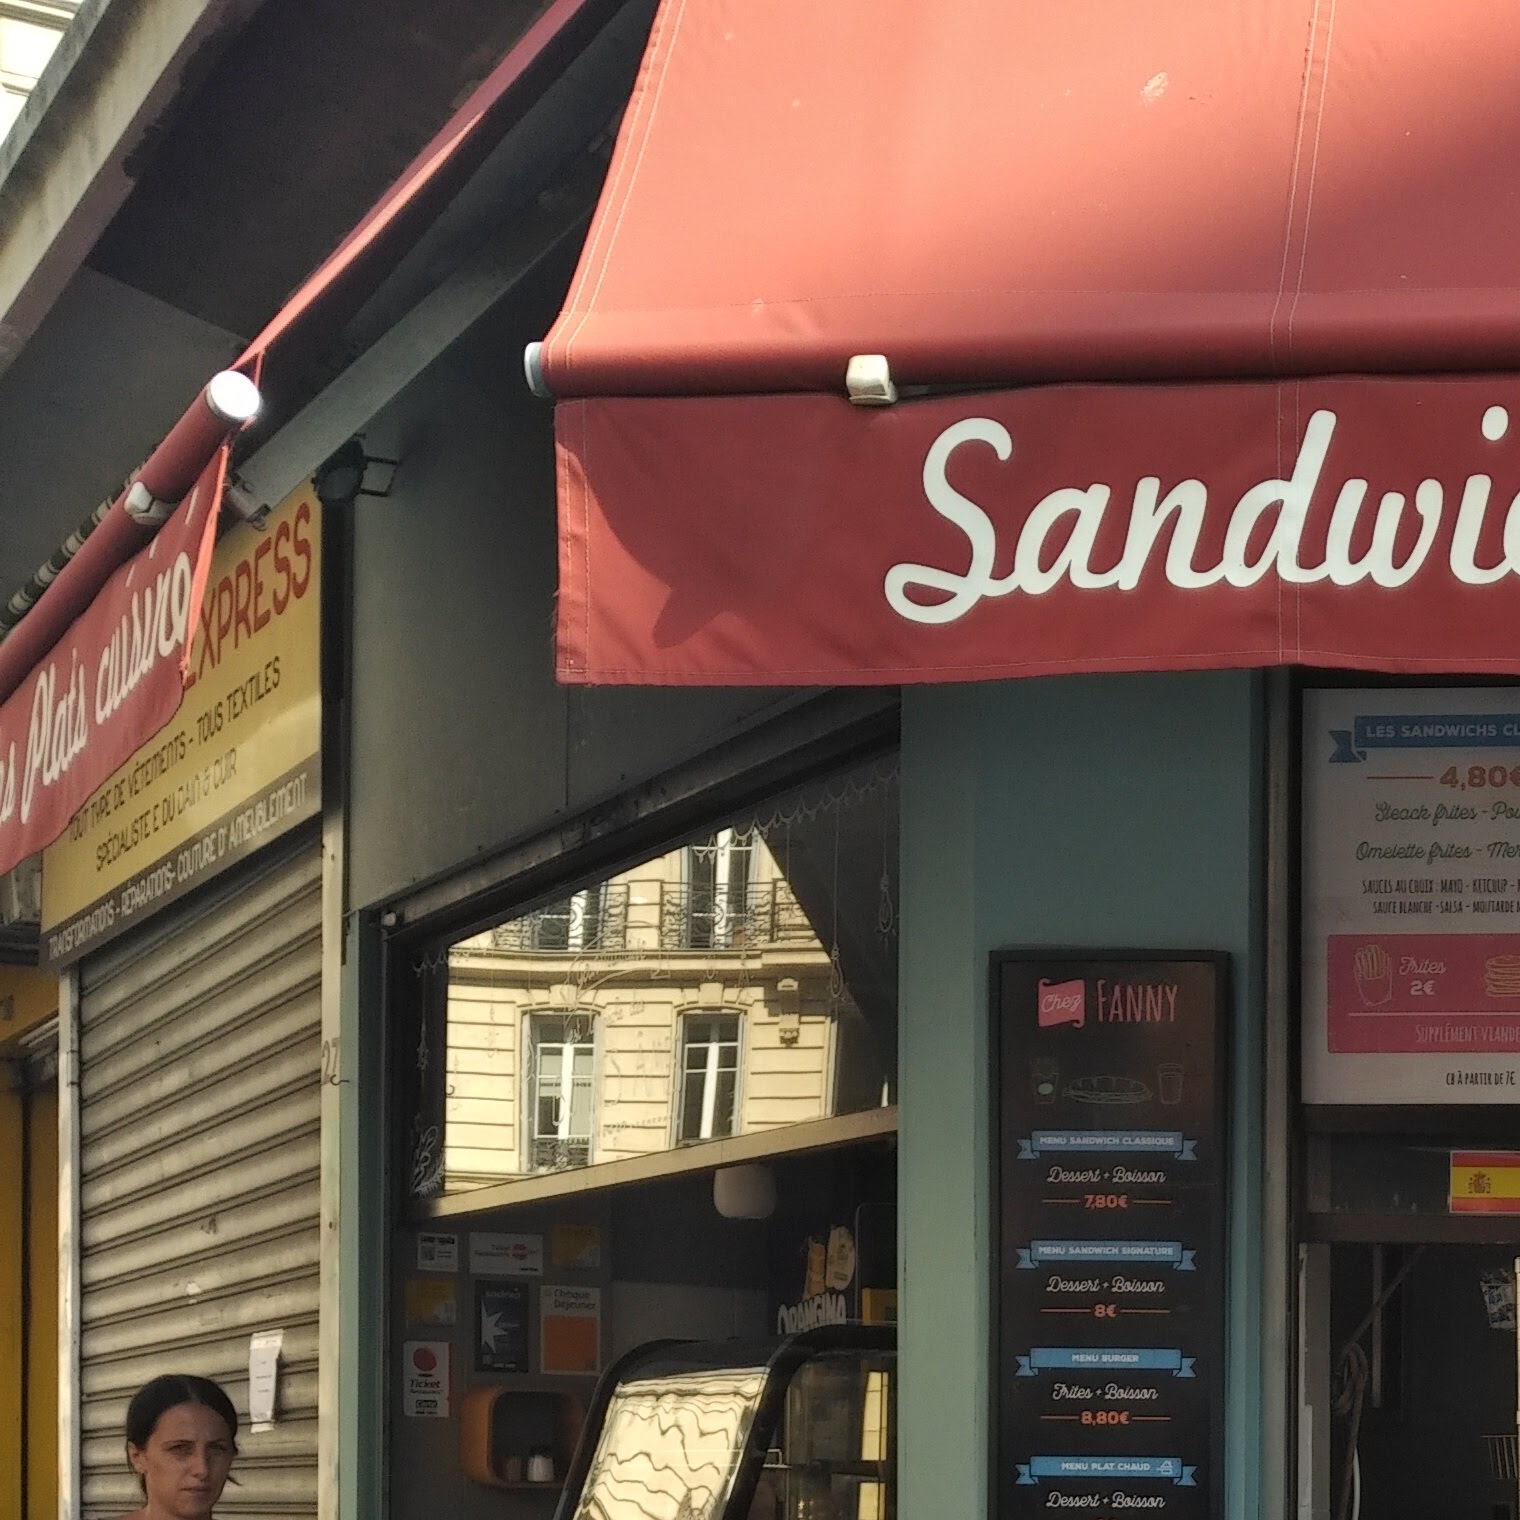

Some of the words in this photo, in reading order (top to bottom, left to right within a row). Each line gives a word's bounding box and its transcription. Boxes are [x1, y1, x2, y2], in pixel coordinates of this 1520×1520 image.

[185, 502, 312, 690] XPRESS
[113, 778, 125, 811] DE
[197, 701, 224, 745] TOUS
[227, 656, 281, 723] TEXTILES
[1365, 724, 1394, 737] LES
[1400, 723, 1497, 737] SANDWICHS
[162, 791, 175, 827] DU
[1374, 801, 1430, 822] Steack
[1432, 803, 1477, 827] frites
[1356, 841, 1425, 861] Omelette
[1427, 842, 1472, 865] frites
[1399, 956, 1447, 976] Frites
[1410, 980, 1436, 996] 2€
[1040, 993, 1082, 1013] Chez
[1097, 979, 1179, 1023] FANNY
[1040, 1136, 1067, 1145] MENU
[1070, 1136, 1120, 1145] SANDWICH
[1122, 1136, 1174, 1145] CLASSIQUE
[1046, 1166, 1102, 1184] Dessert
[1112, 1166, 1166, 1183] Boisson
[1038, 1246, 1065, 1255] MENU
[1069, 1246, 1119, 1255] SANDWICH
[1121, 1246, 1173, 1256] SIGNATURE
[1046, 1275, 1100, 1293] Dessert
[1111, 1276, 1165, 1293] Boisson
[1094, 1304, 1117, 1318] 8€
[1072, 1354, 1099, 1363] MENU
[1101, 1354, 1139, 1363] BURGER
[410, 1379, 441, 1389] Ticket
[1052, 1383, 1093, 1401] Frites
[1104, 1384, 1158, 1400] Boisson
[1080, 1411, 1130, 1426] 8,80€
[1061, 1462, 1088, 1471] MENU
[1091, 1462, 1114, 1471] PLAT
[1117, 1462, 1150, 1471] CHAUD
[1046, 1491, 1100, 1509] Dessert
[1111, 1492, 1165, 1509] Boisson
